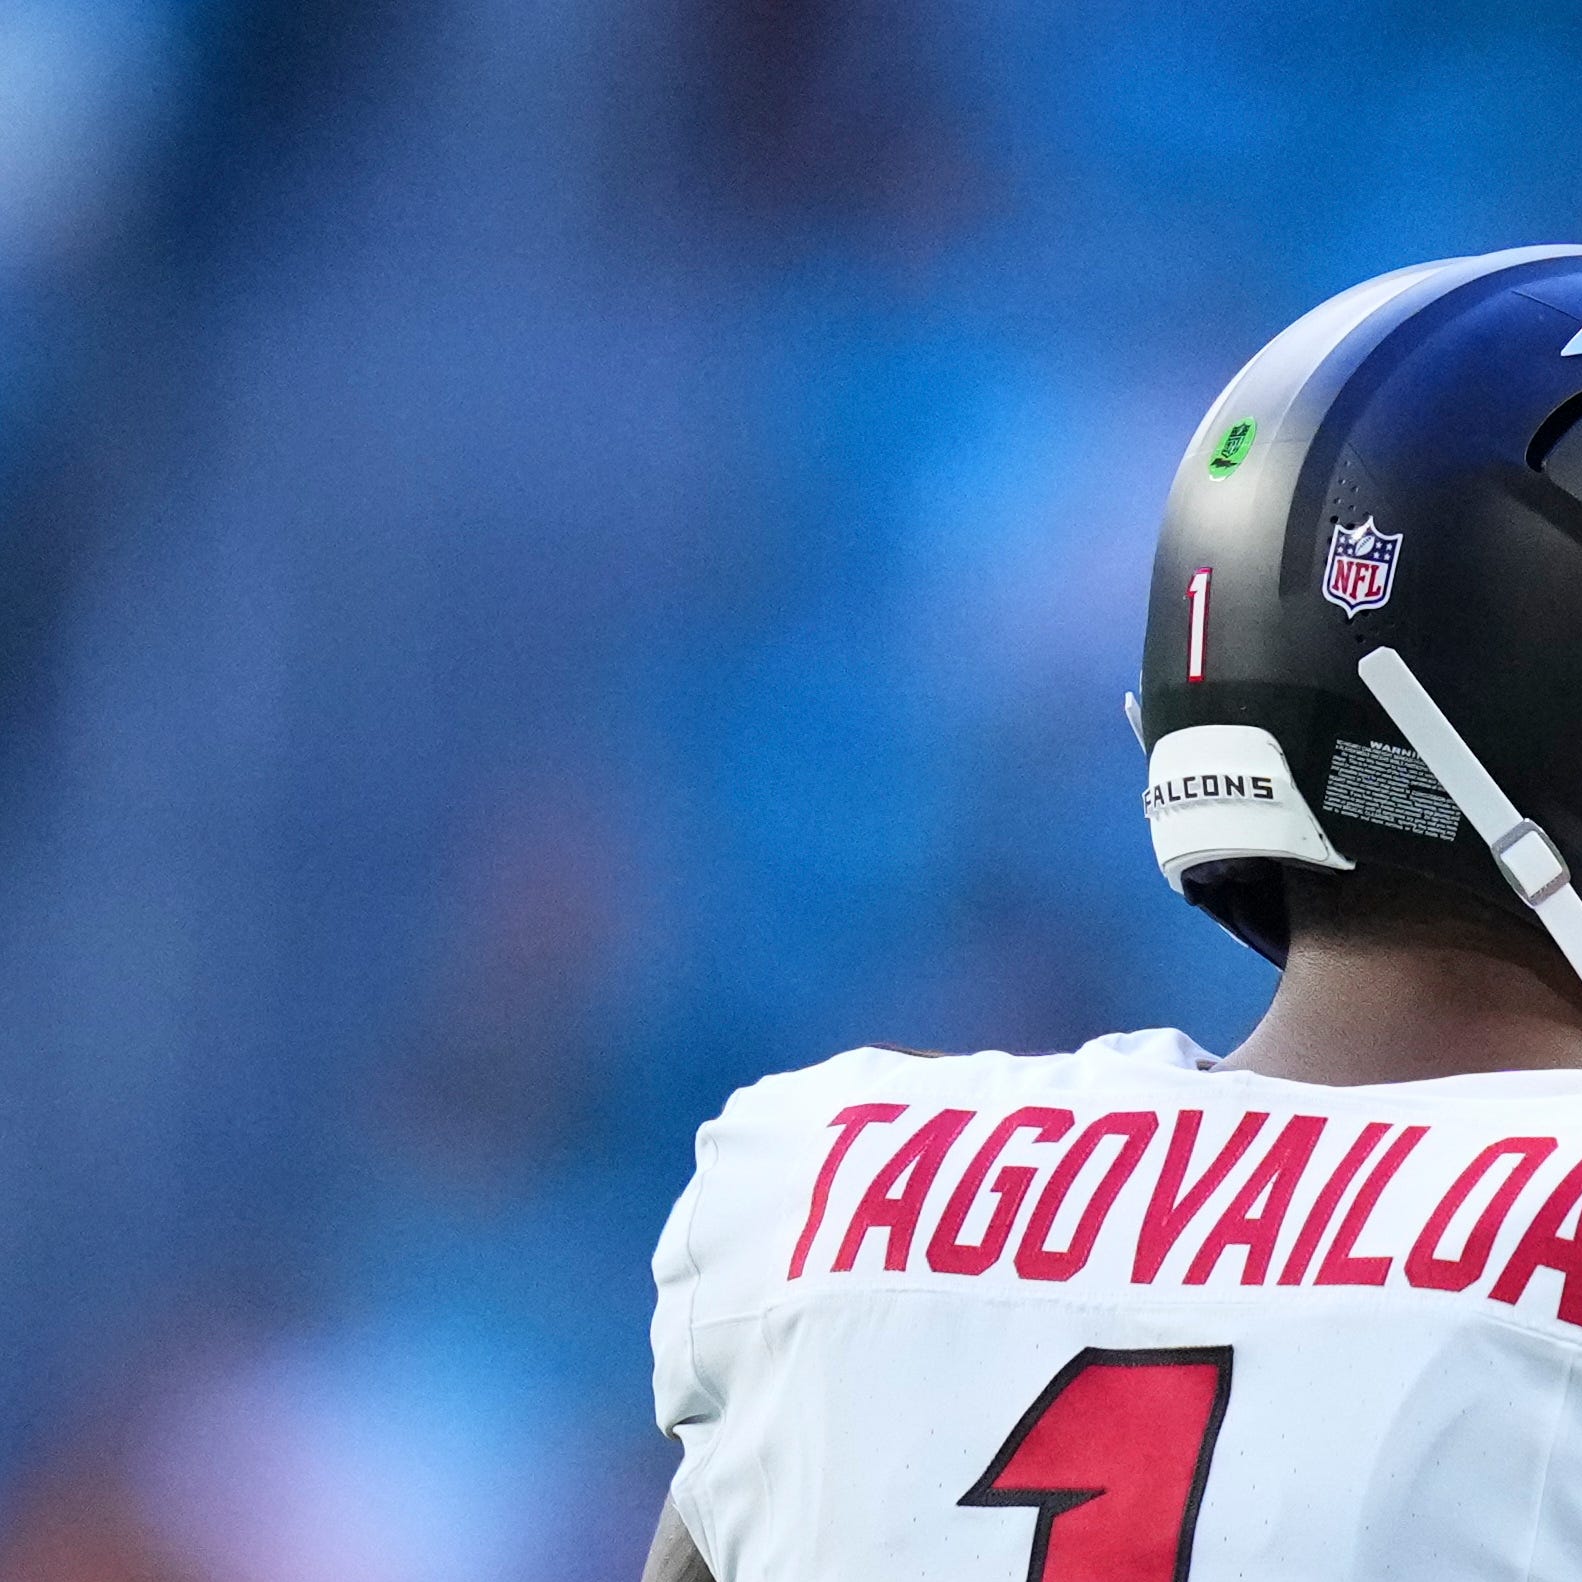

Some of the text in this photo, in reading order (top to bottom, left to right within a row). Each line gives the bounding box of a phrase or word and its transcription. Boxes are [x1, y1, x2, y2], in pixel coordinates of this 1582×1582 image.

[1332, 560, 1383, 600] NFL
[1184, 566, 1212, 684] 1
[1370, 740, 1422, 761] WARNI
[1144, 774, 1275, 816] FALCONS
